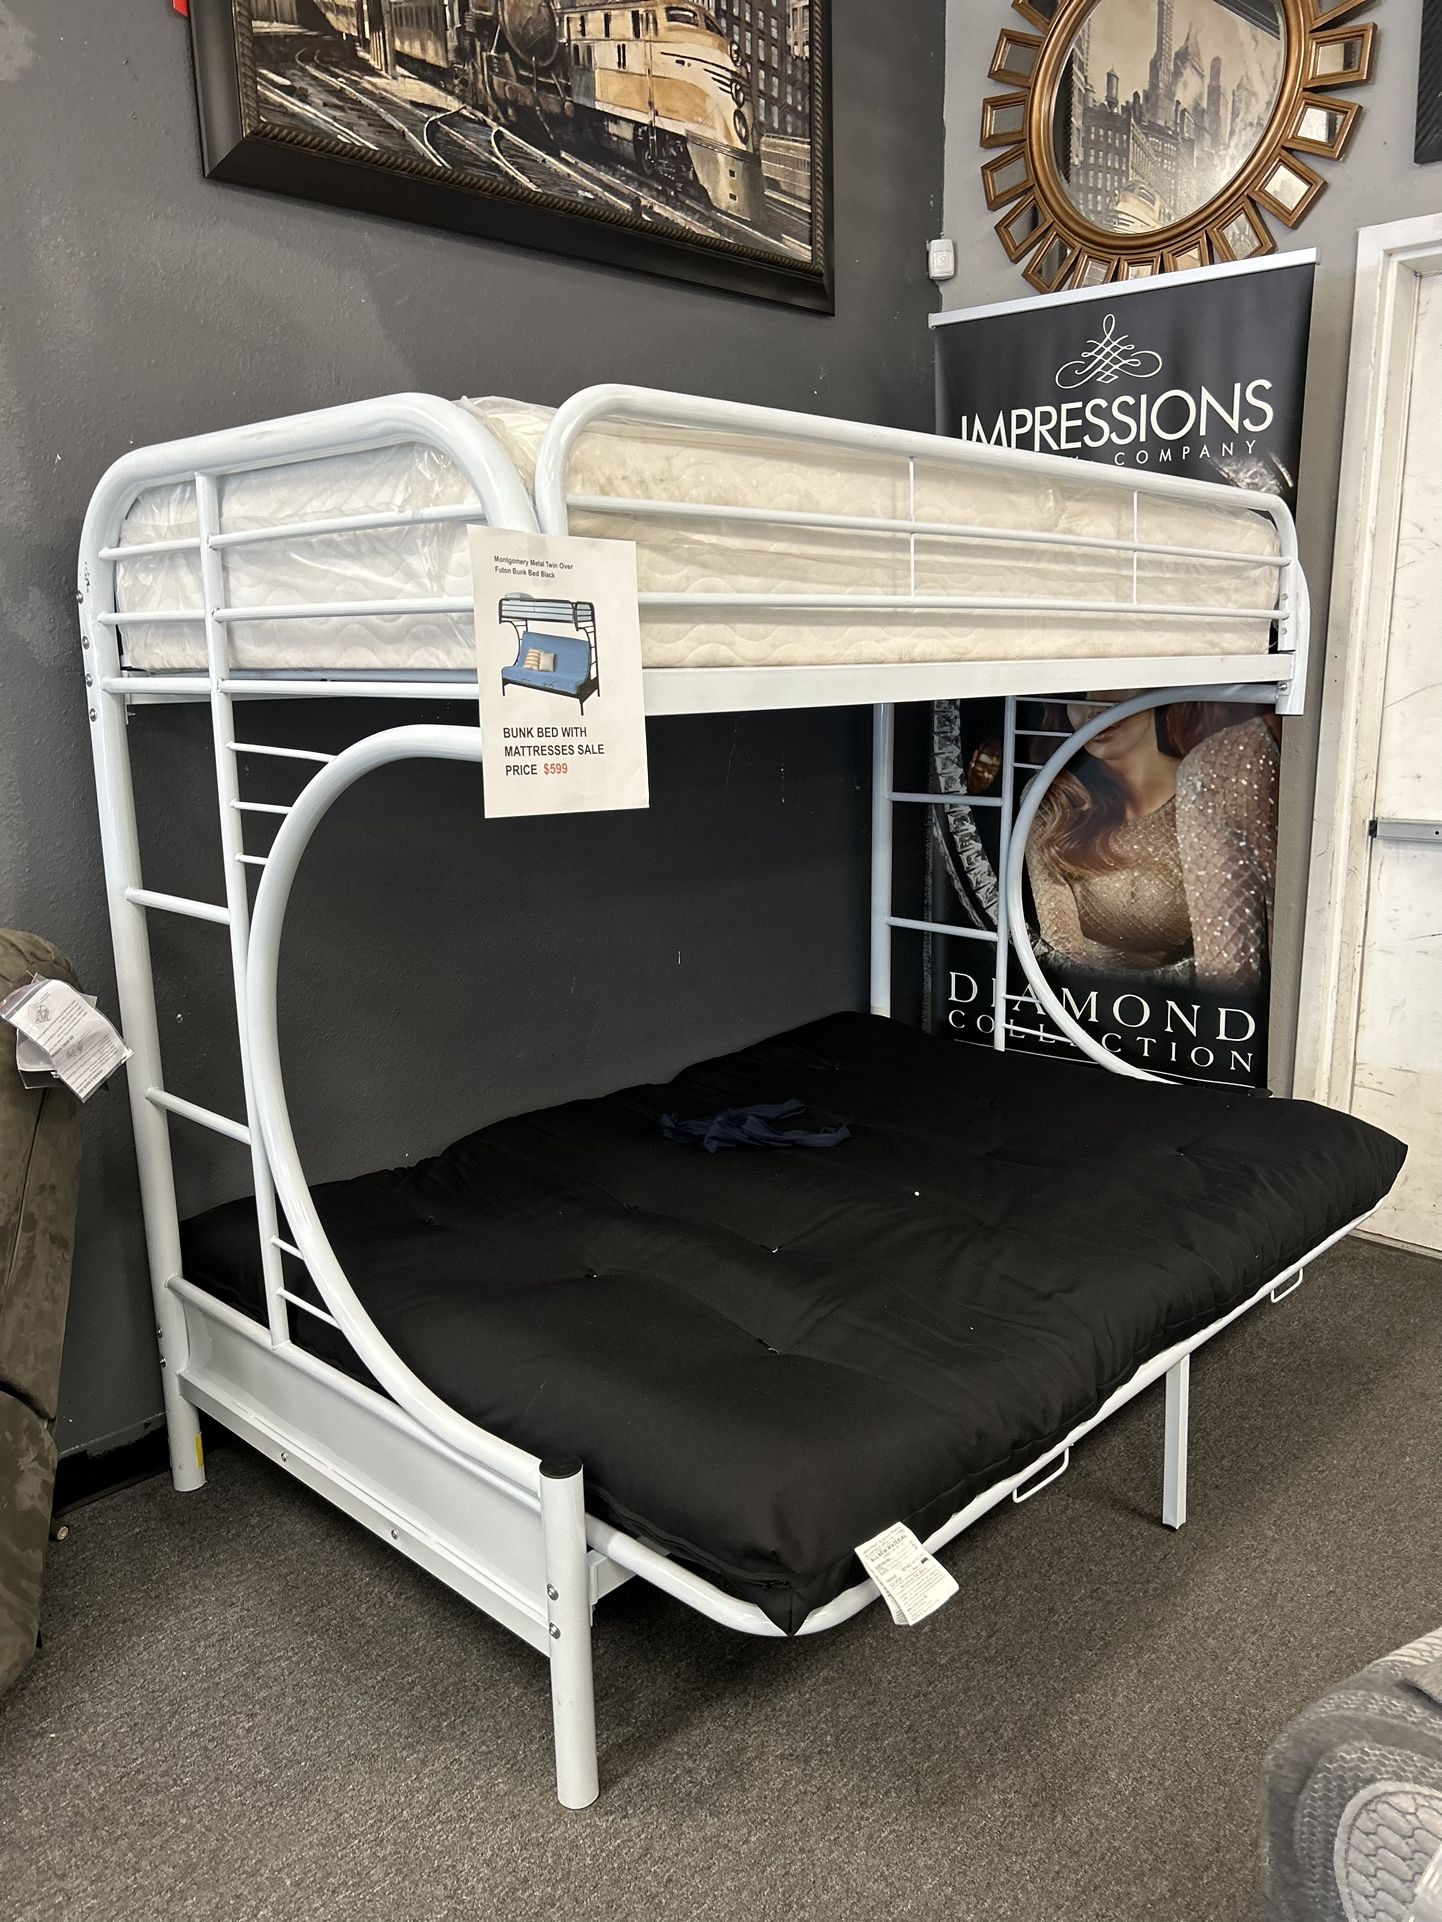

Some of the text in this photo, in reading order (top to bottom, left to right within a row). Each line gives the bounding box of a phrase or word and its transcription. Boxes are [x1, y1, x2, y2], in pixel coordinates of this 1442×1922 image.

[961, 379, 1274, 451] IMPRESSIONS
[1114, 440, 1256, 465] COMPANY
[494, 555, 573, 570] Montgomery Metal Twin Over
[494, 565, 555, 578] Futon Bunk Bed Black
[503, 726, 587, 738] BUNK BED WITH
[504, 743, 605, 757] MATTRESSES SALE
[505, 762, 568, 776] PRICE $599
[948, 971, 1256, 1042] DIAMOND
[948, 1009, 1253, 1073] COLLCTION
